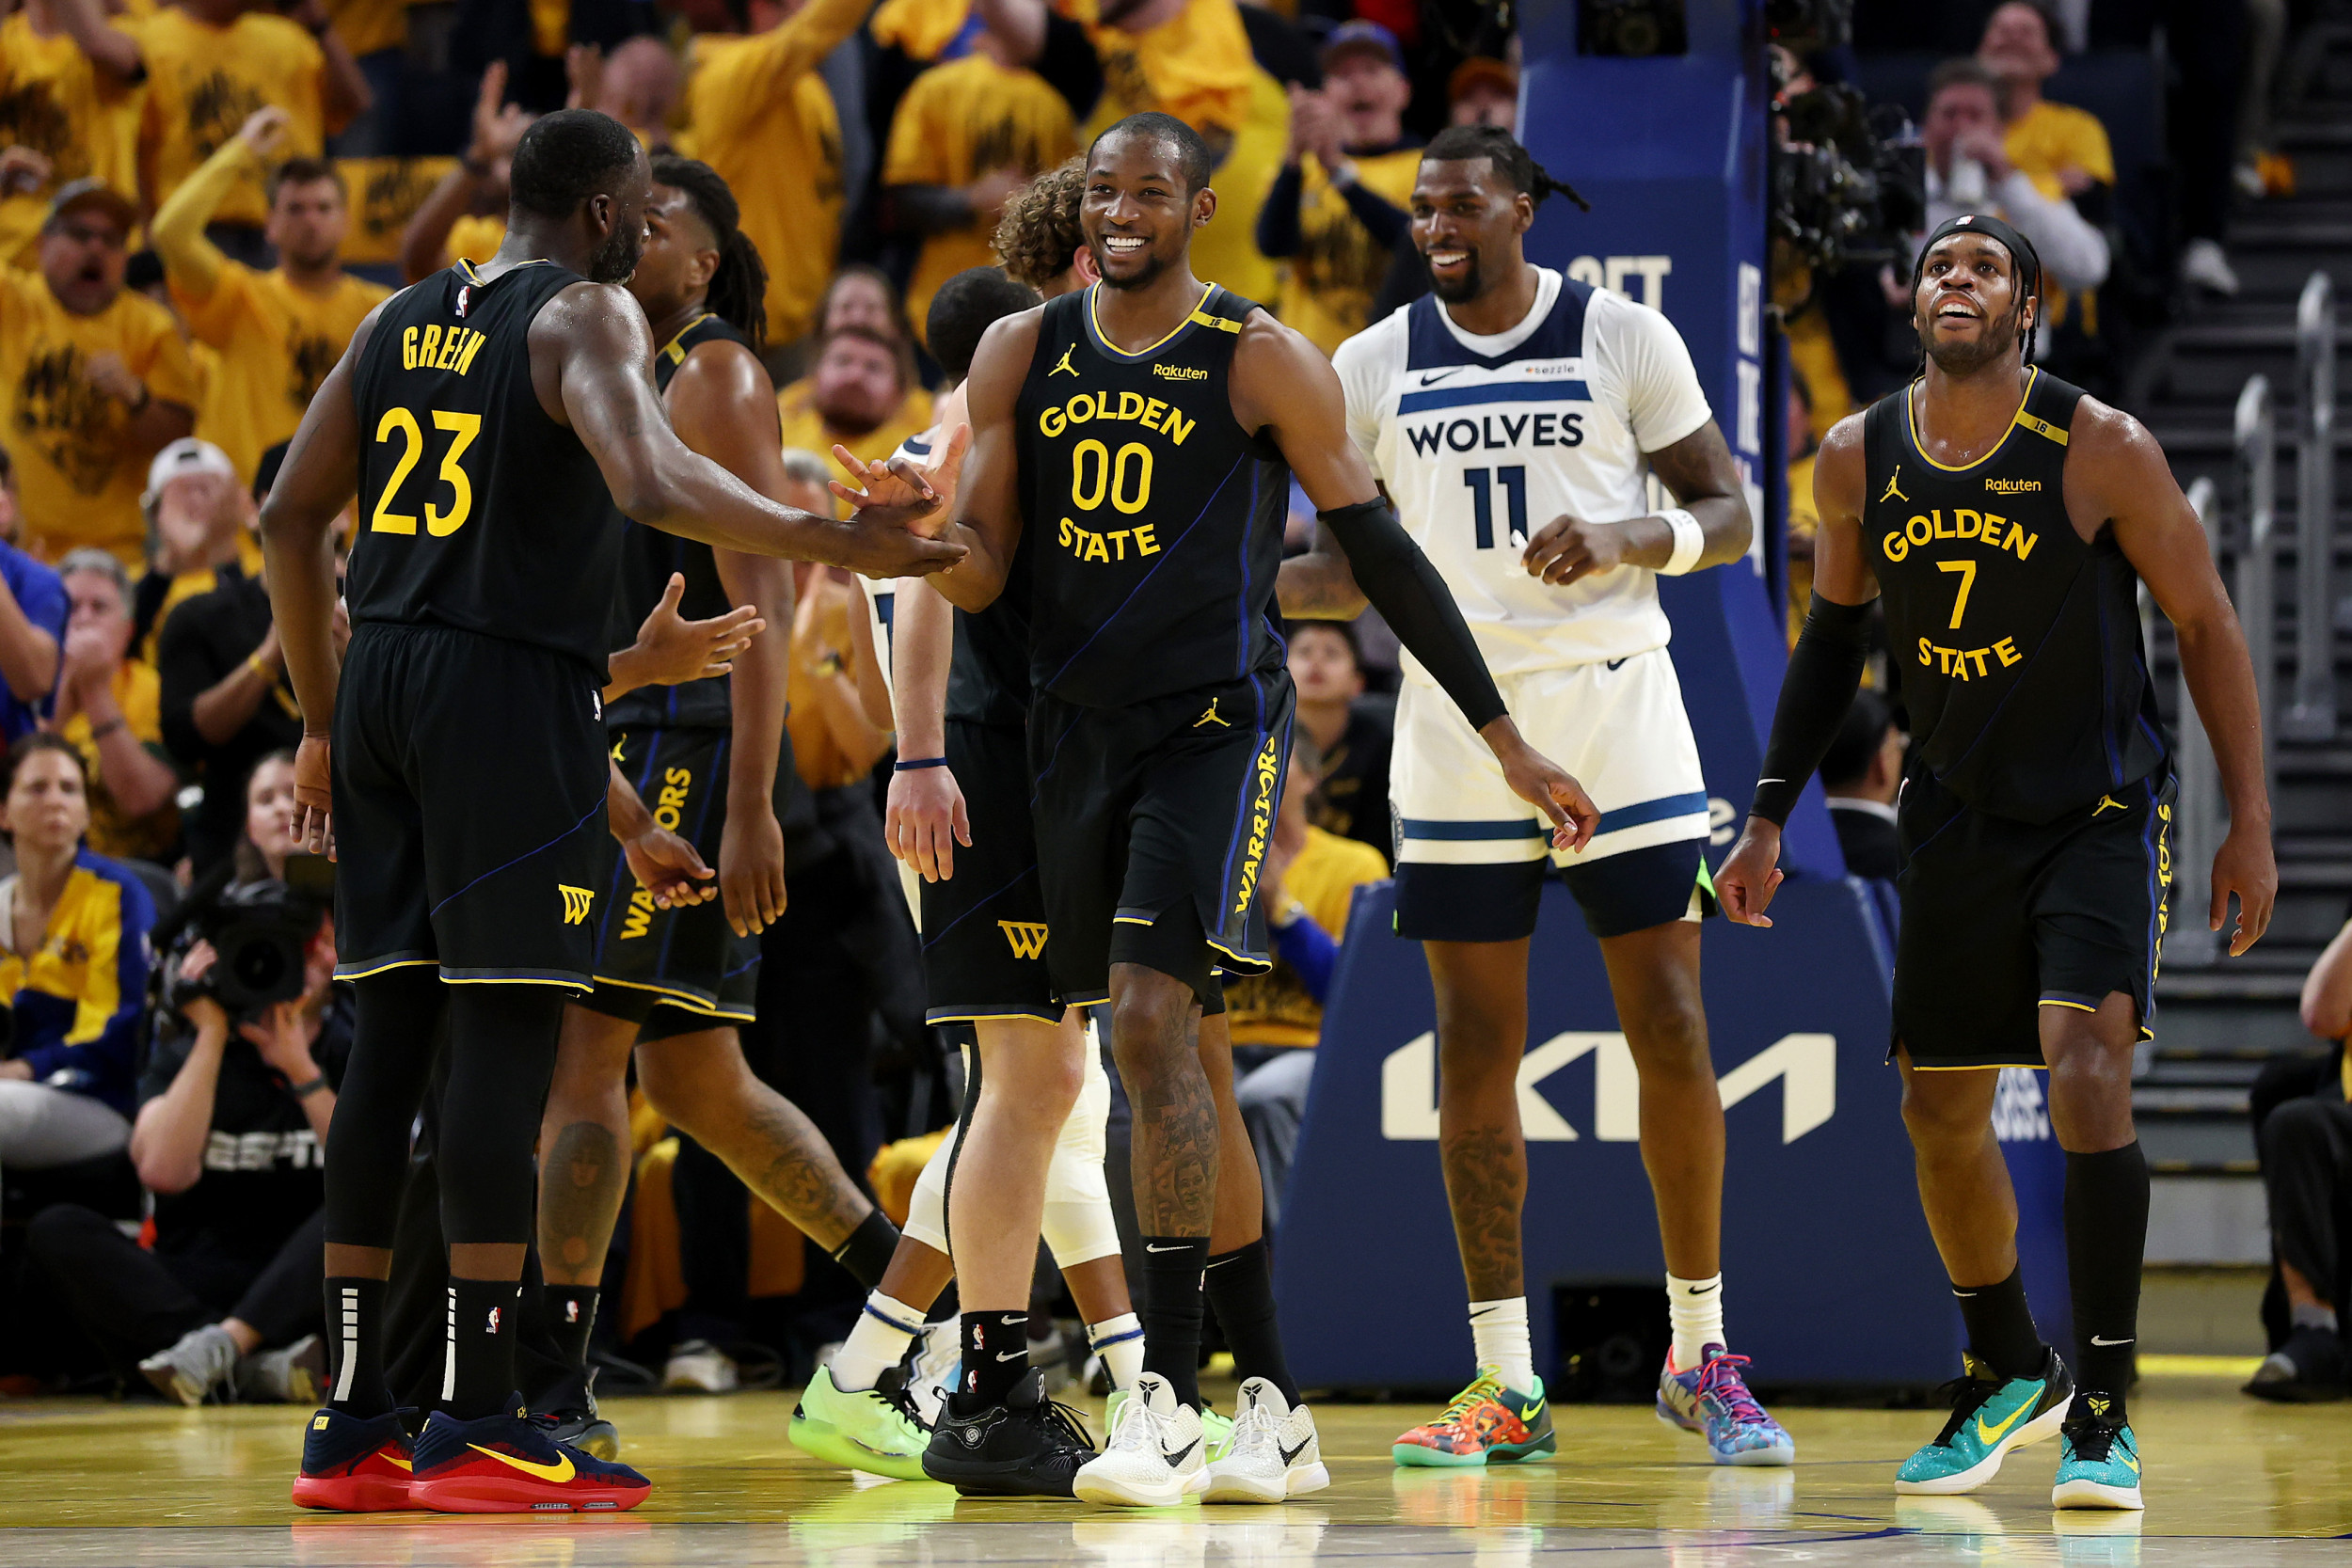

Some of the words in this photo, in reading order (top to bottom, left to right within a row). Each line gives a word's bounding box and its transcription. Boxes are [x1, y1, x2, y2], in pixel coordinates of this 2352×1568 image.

[403, 324, 486, 376] GREEN
[1152, 363, 1208, 380] Rakuten
[1040, 390, 1197, 446] GOLDEN
[1406, 413, 1584, 458] WOLVES
[2033, 420, 2047, 433] 16
[371, 406, 482, 537] 23
[1072, 438, 1153, 515] 00
[1985, 478, 2042, 495] Rakuten
[1464, 466, 1529, 549] 11
[1058, 516, 1161, 563] STATE
[1883, 509, 2039, 562] GOLDEN
[1935, 560, 1977, 629] 7
[1918, 635, 2023, 682] STATE
[1234, 736, 1278, 913] WARRIORS
[620, 767, 691, 941] WAORS
